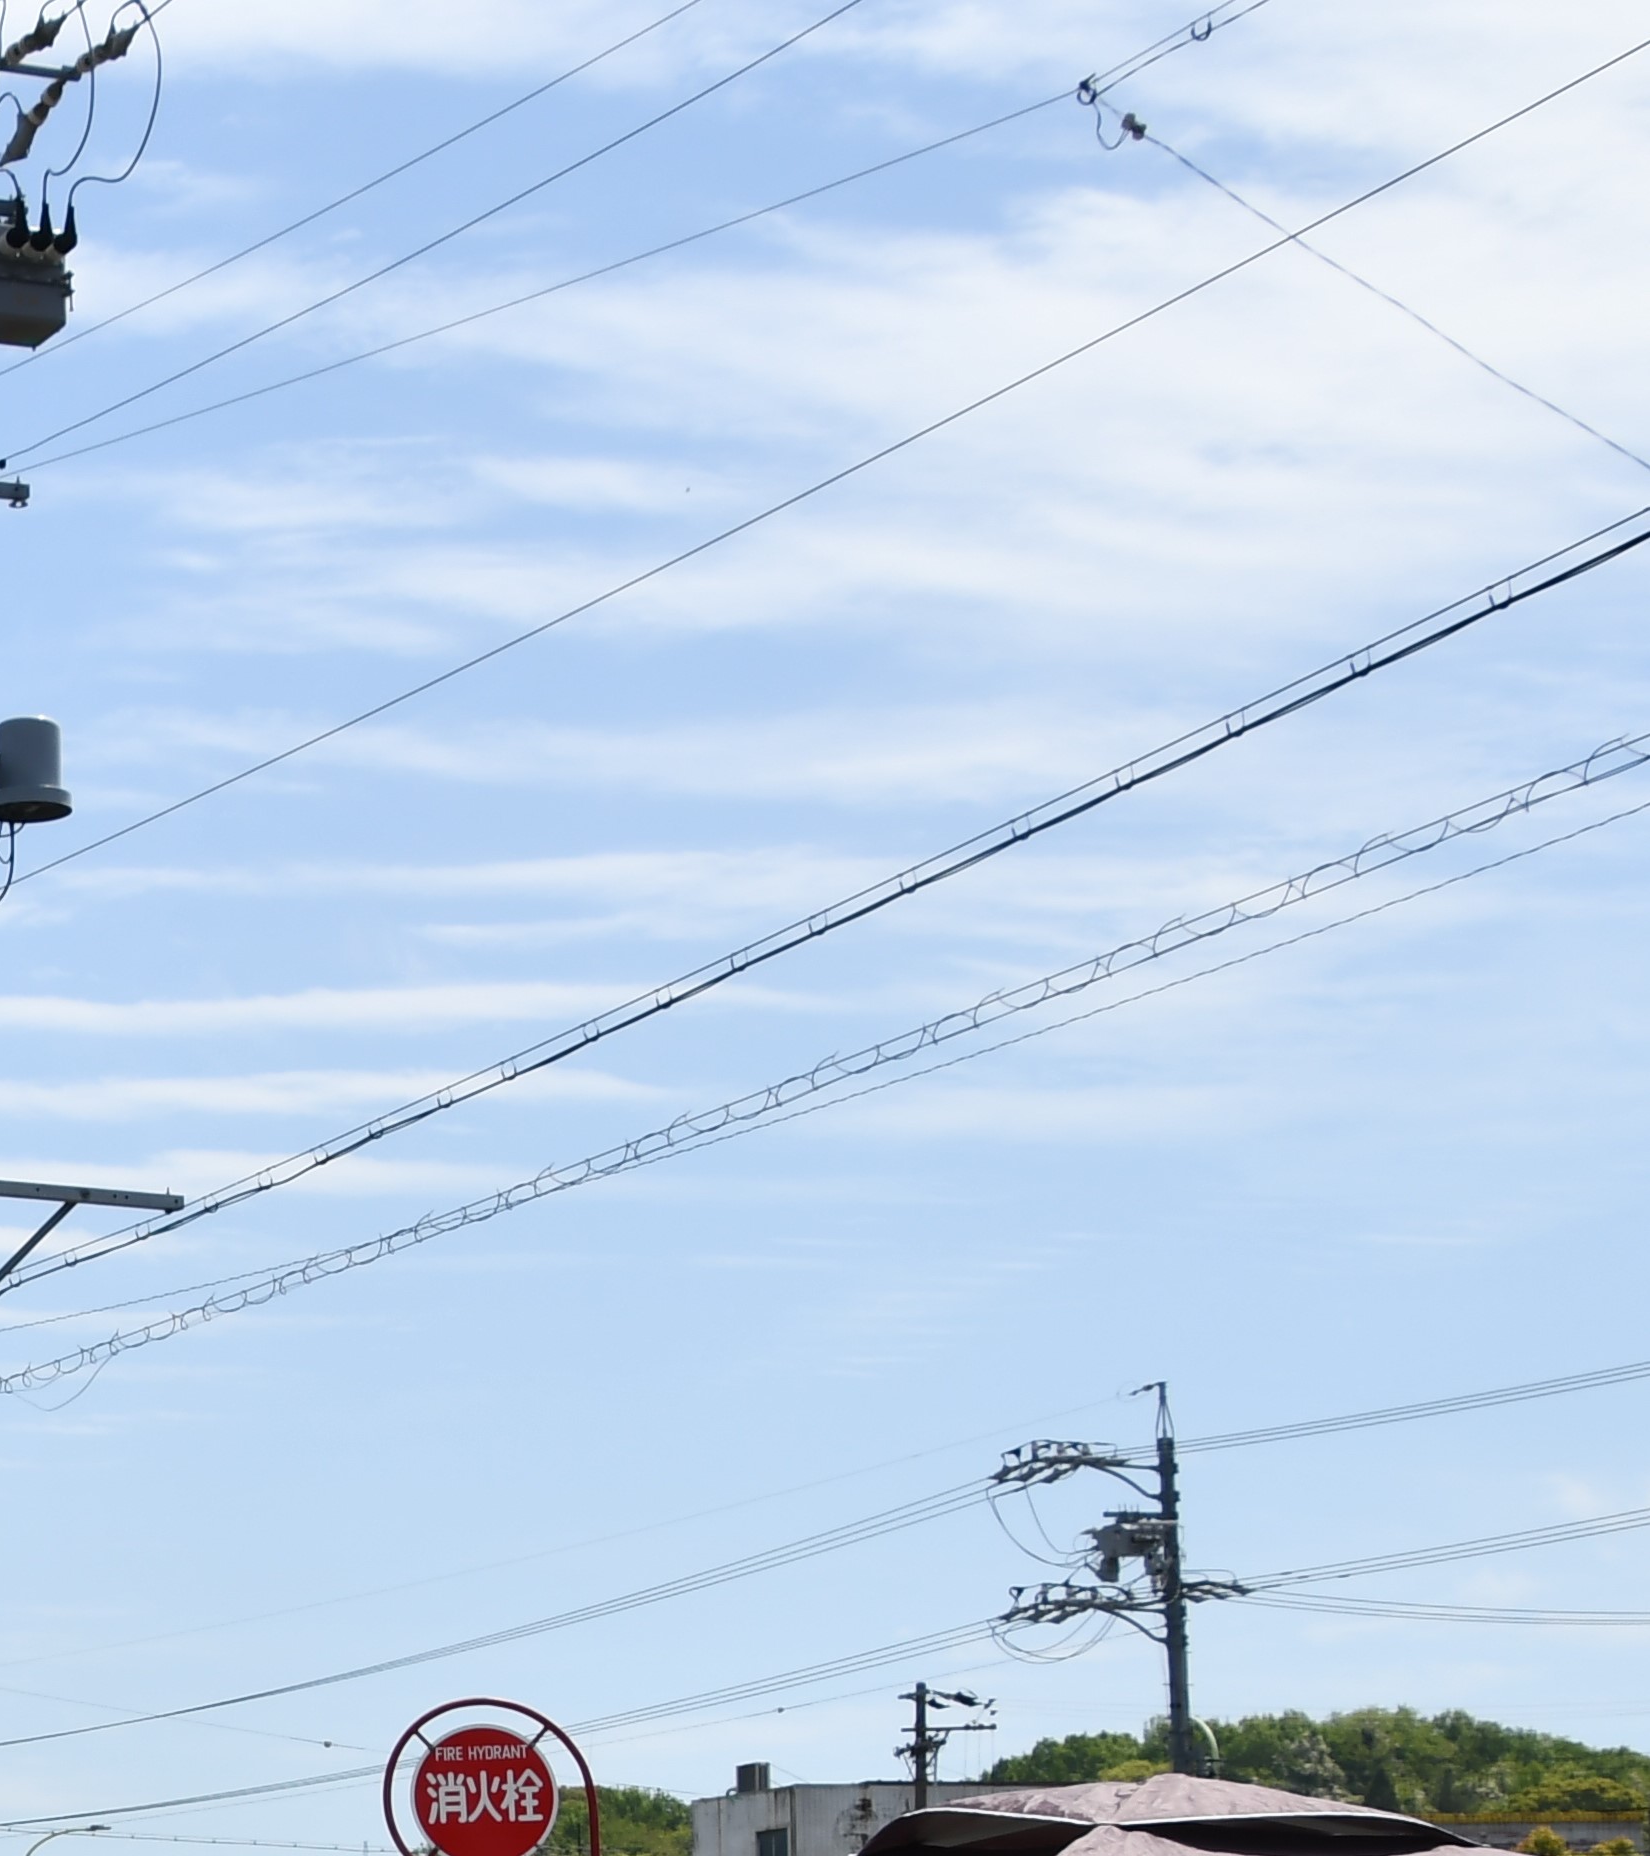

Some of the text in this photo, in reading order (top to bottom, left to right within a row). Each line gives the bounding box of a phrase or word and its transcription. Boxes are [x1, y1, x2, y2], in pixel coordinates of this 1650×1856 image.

[434, 1744, 527, 1762] FIRE HYDRANT
[425, 1768, 544, 1825] 消火栓
